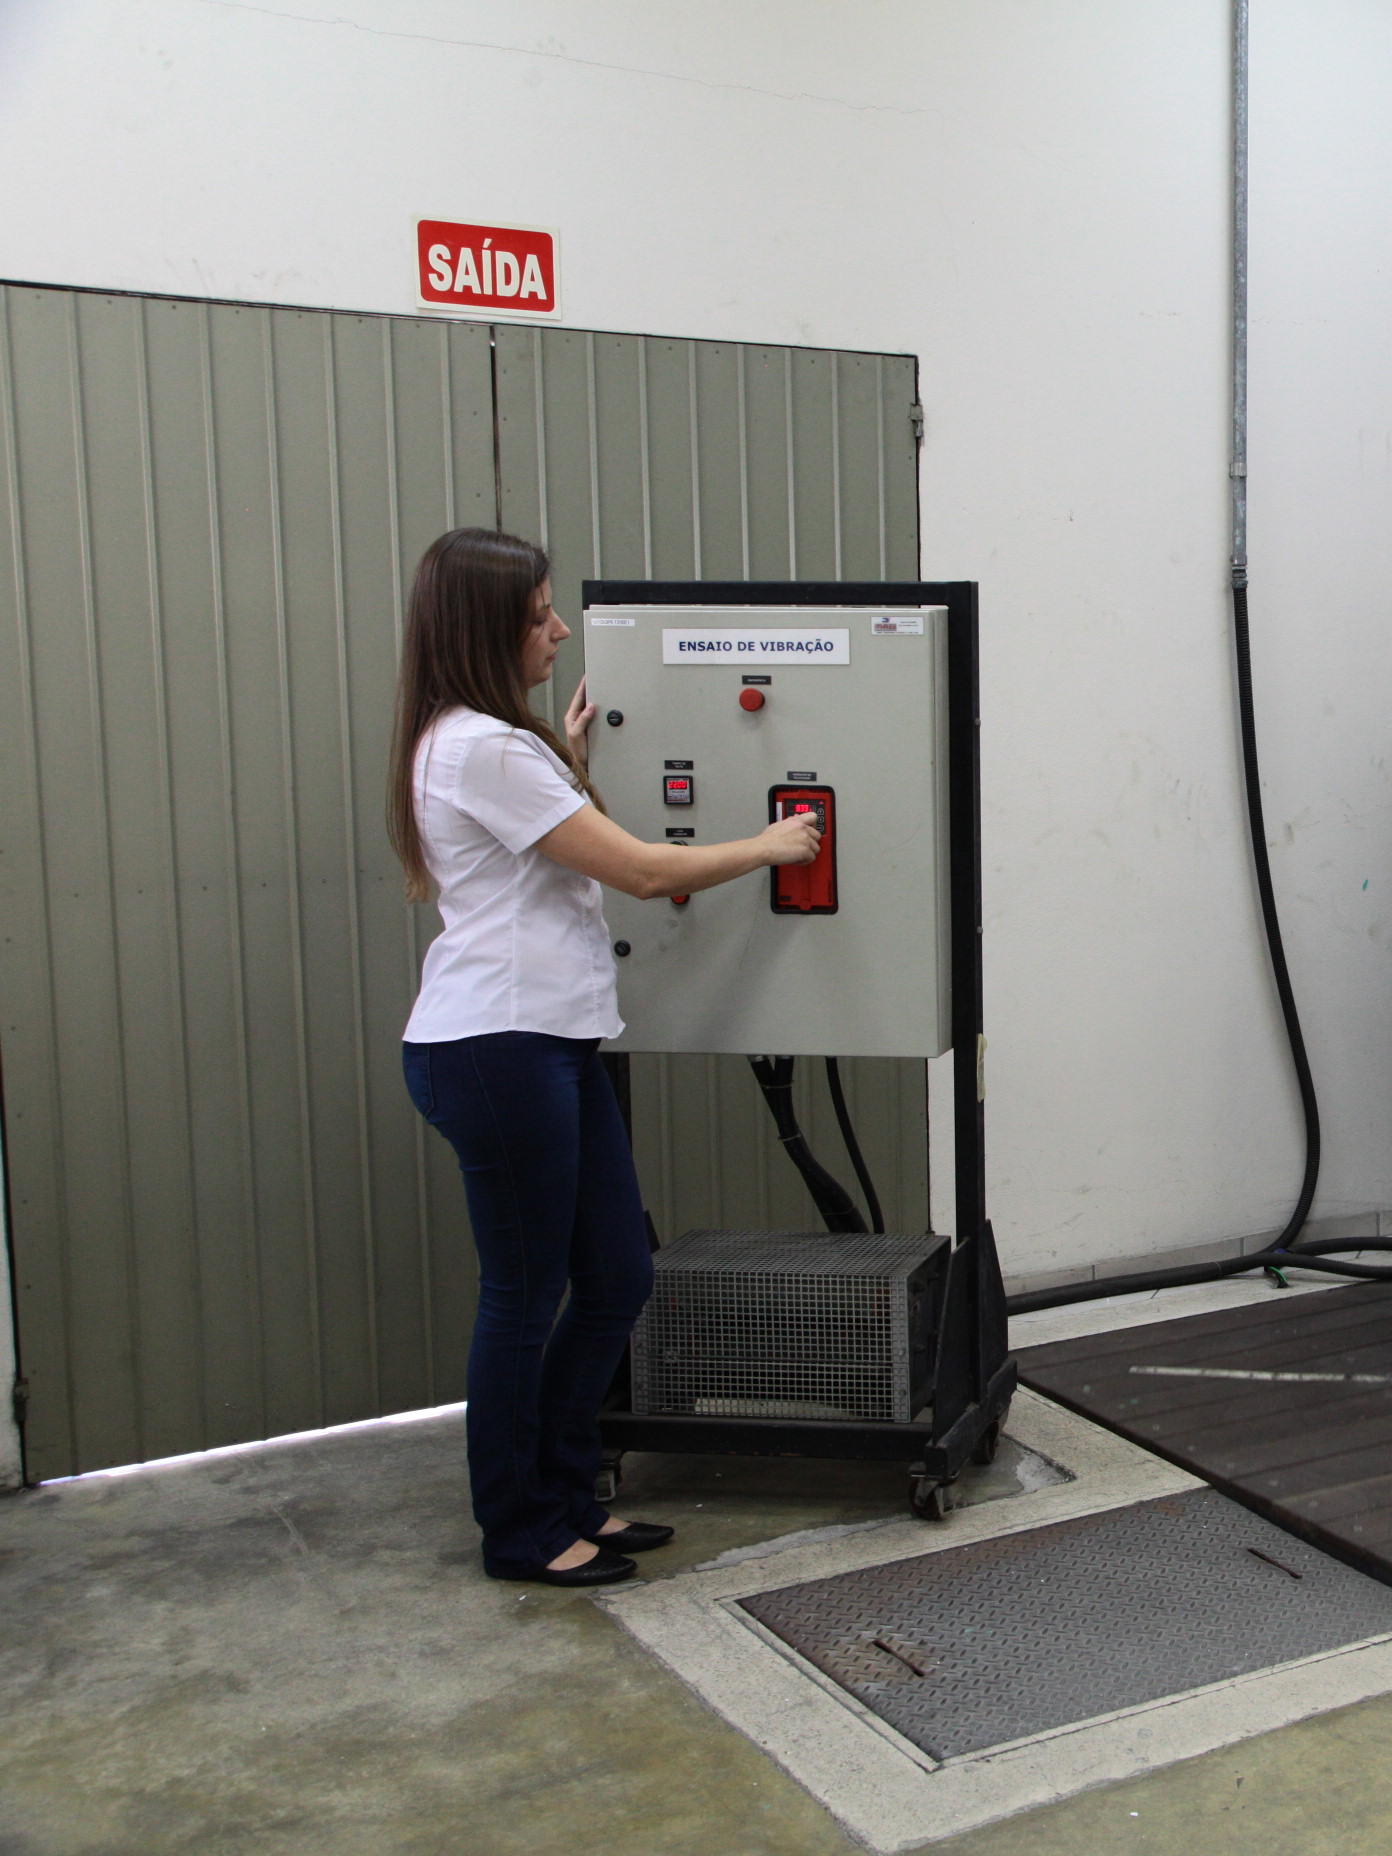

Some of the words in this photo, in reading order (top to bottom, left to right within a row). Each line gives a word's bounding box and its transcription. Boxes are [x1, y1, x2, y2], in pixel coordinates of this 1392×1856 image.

[428, 238, 547, 300] SAÍDA
[679, 641, 732, 652] ENSAIO
[737, 641, 755, 652] DE
[760, 639, 834, 654] VIBRAÇÃO
